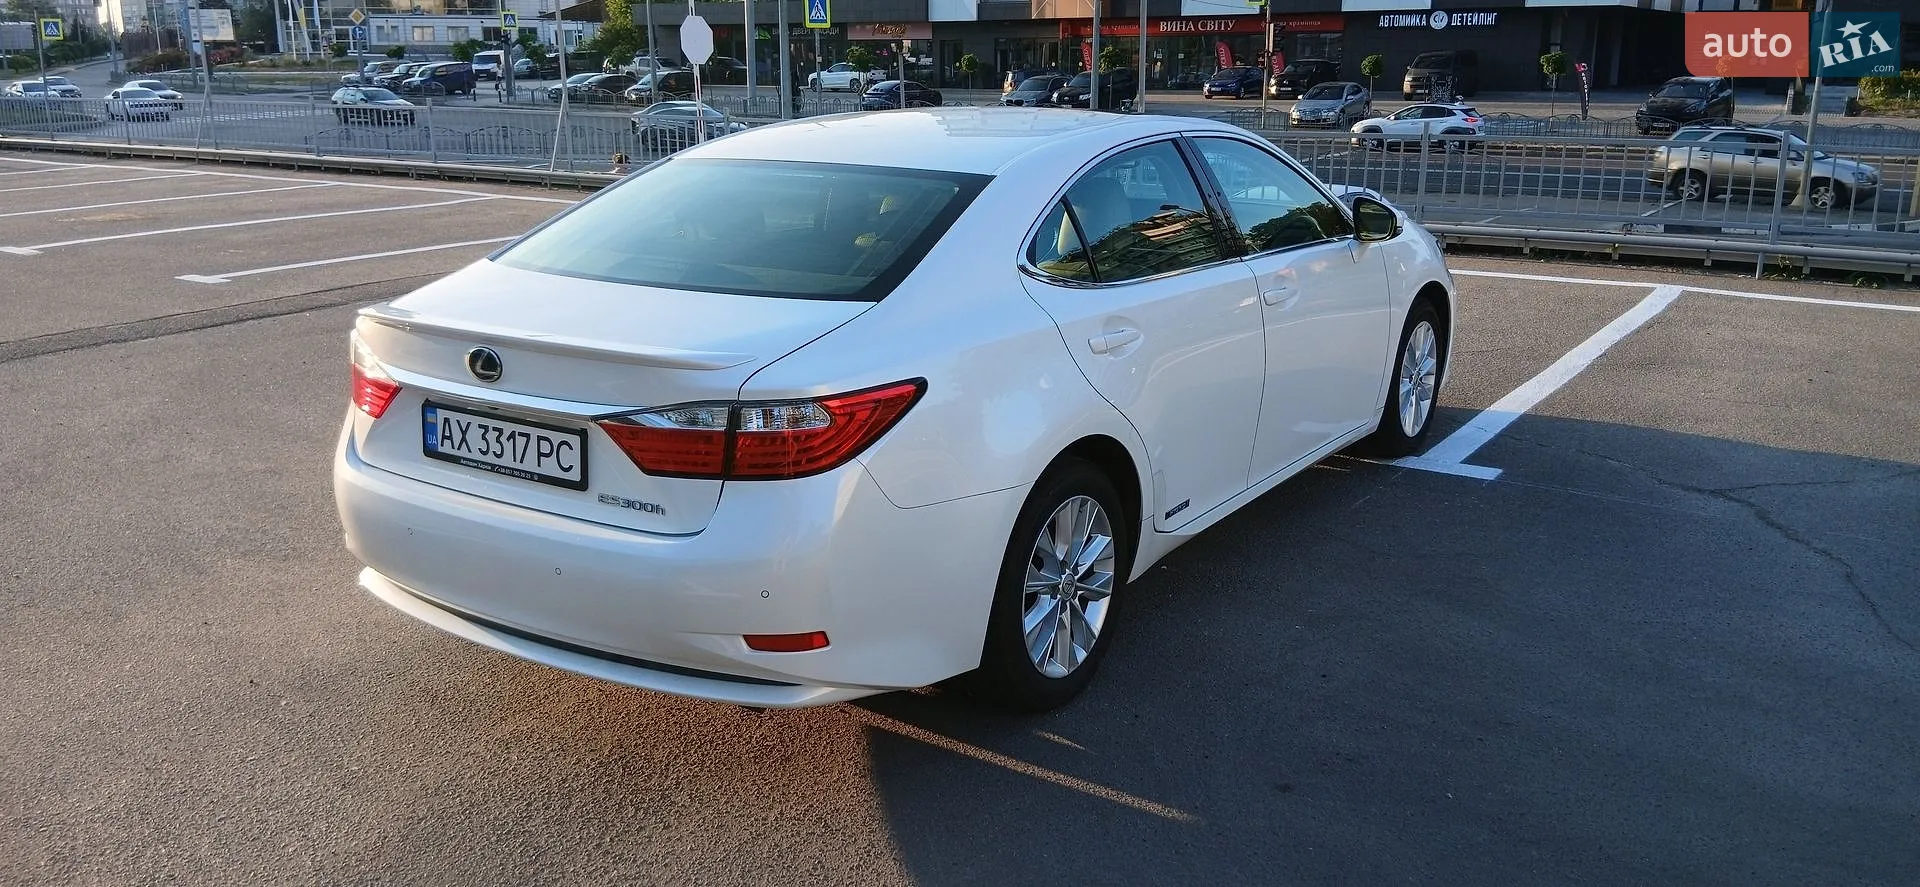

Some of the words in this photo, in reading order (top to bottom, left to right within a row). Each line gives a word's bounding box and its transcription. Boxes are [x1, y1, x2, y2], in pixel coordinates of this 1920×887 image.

[1159, 20, 1195, 32] ВИНА
[1198, 19, 1236, 32] СВІТУ
[1378, 14, 1426, 27] АВТОМИЙКА
[1450, 11, 1498, 26] ДЕТЕЙЛІНГ
[427, 434, 438, 446] UA
[440, 416, 472, 454] AX
[477, 423, 531, 464] 3317
[536, 434, 574, 473] PC
[597, 492, 666, 516] ES300h
